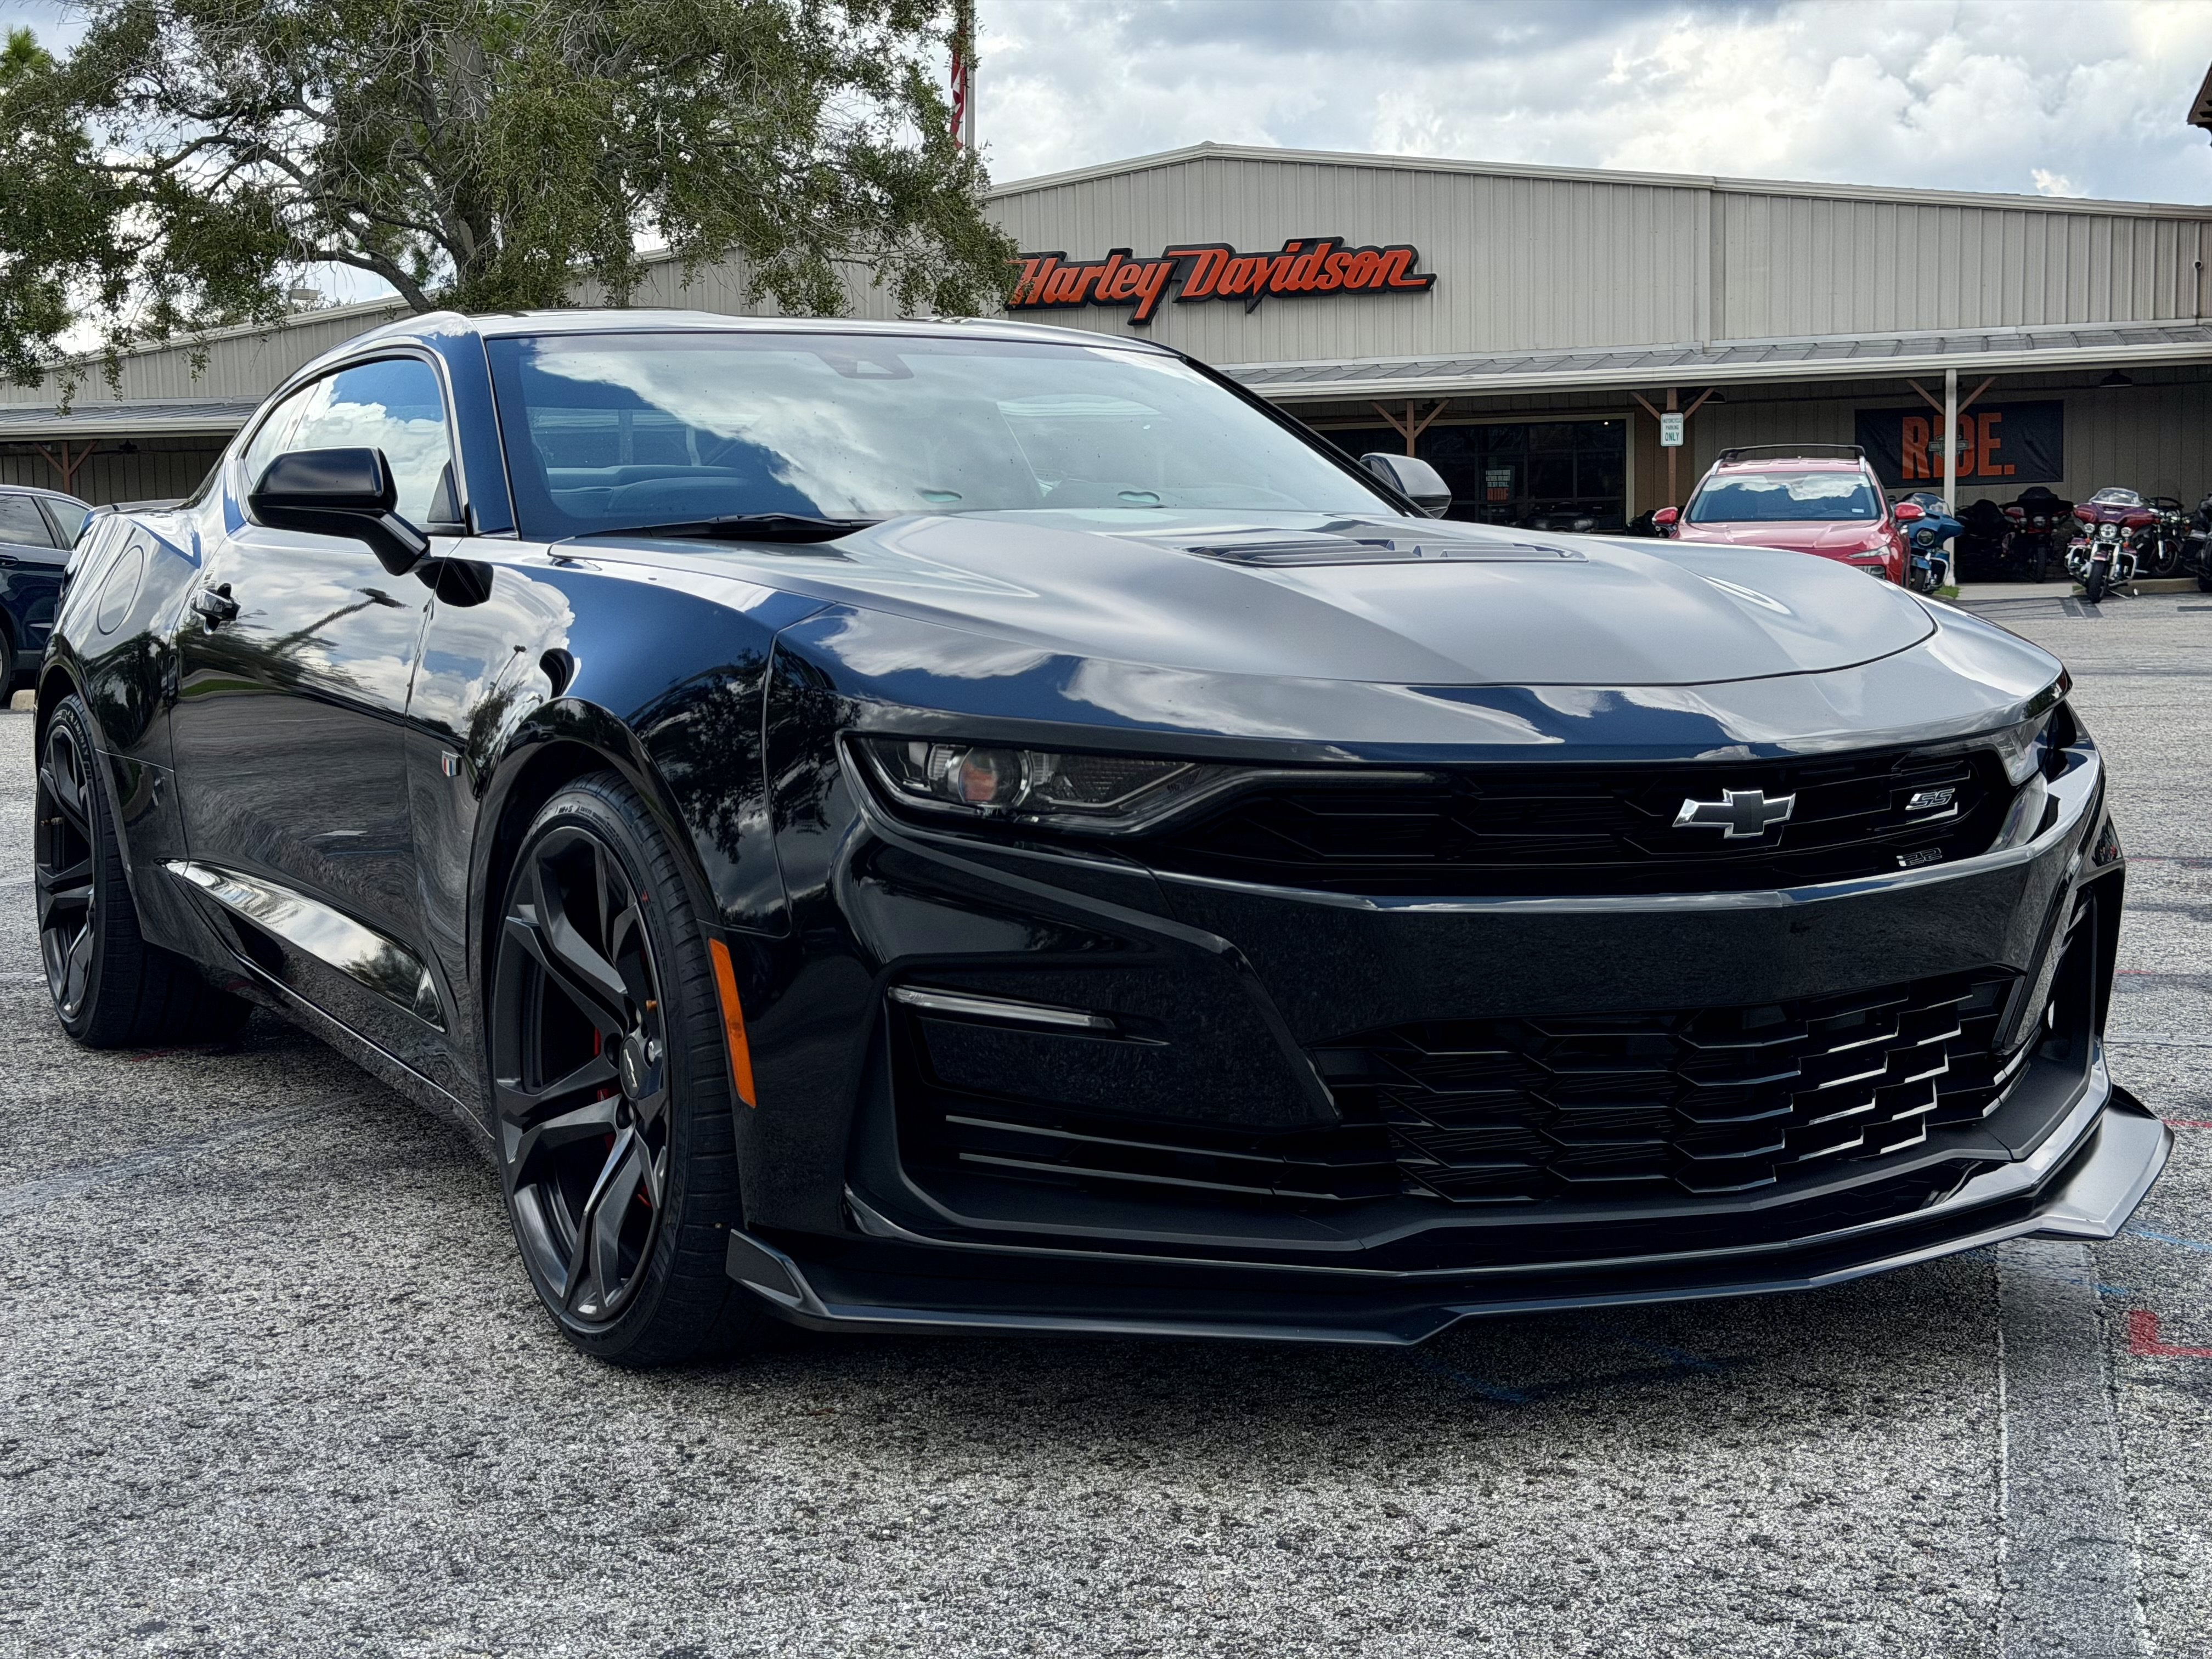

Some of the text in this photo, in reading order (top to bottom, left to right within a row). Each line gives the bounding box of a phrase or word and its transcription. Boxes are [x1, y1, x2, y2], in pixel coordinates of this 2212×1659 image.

[1007, 242, 1427, 319] Harley Davidson
[1664, 432, 1680, 442] ONLY
[1905, 787, 1956, 811] SS
